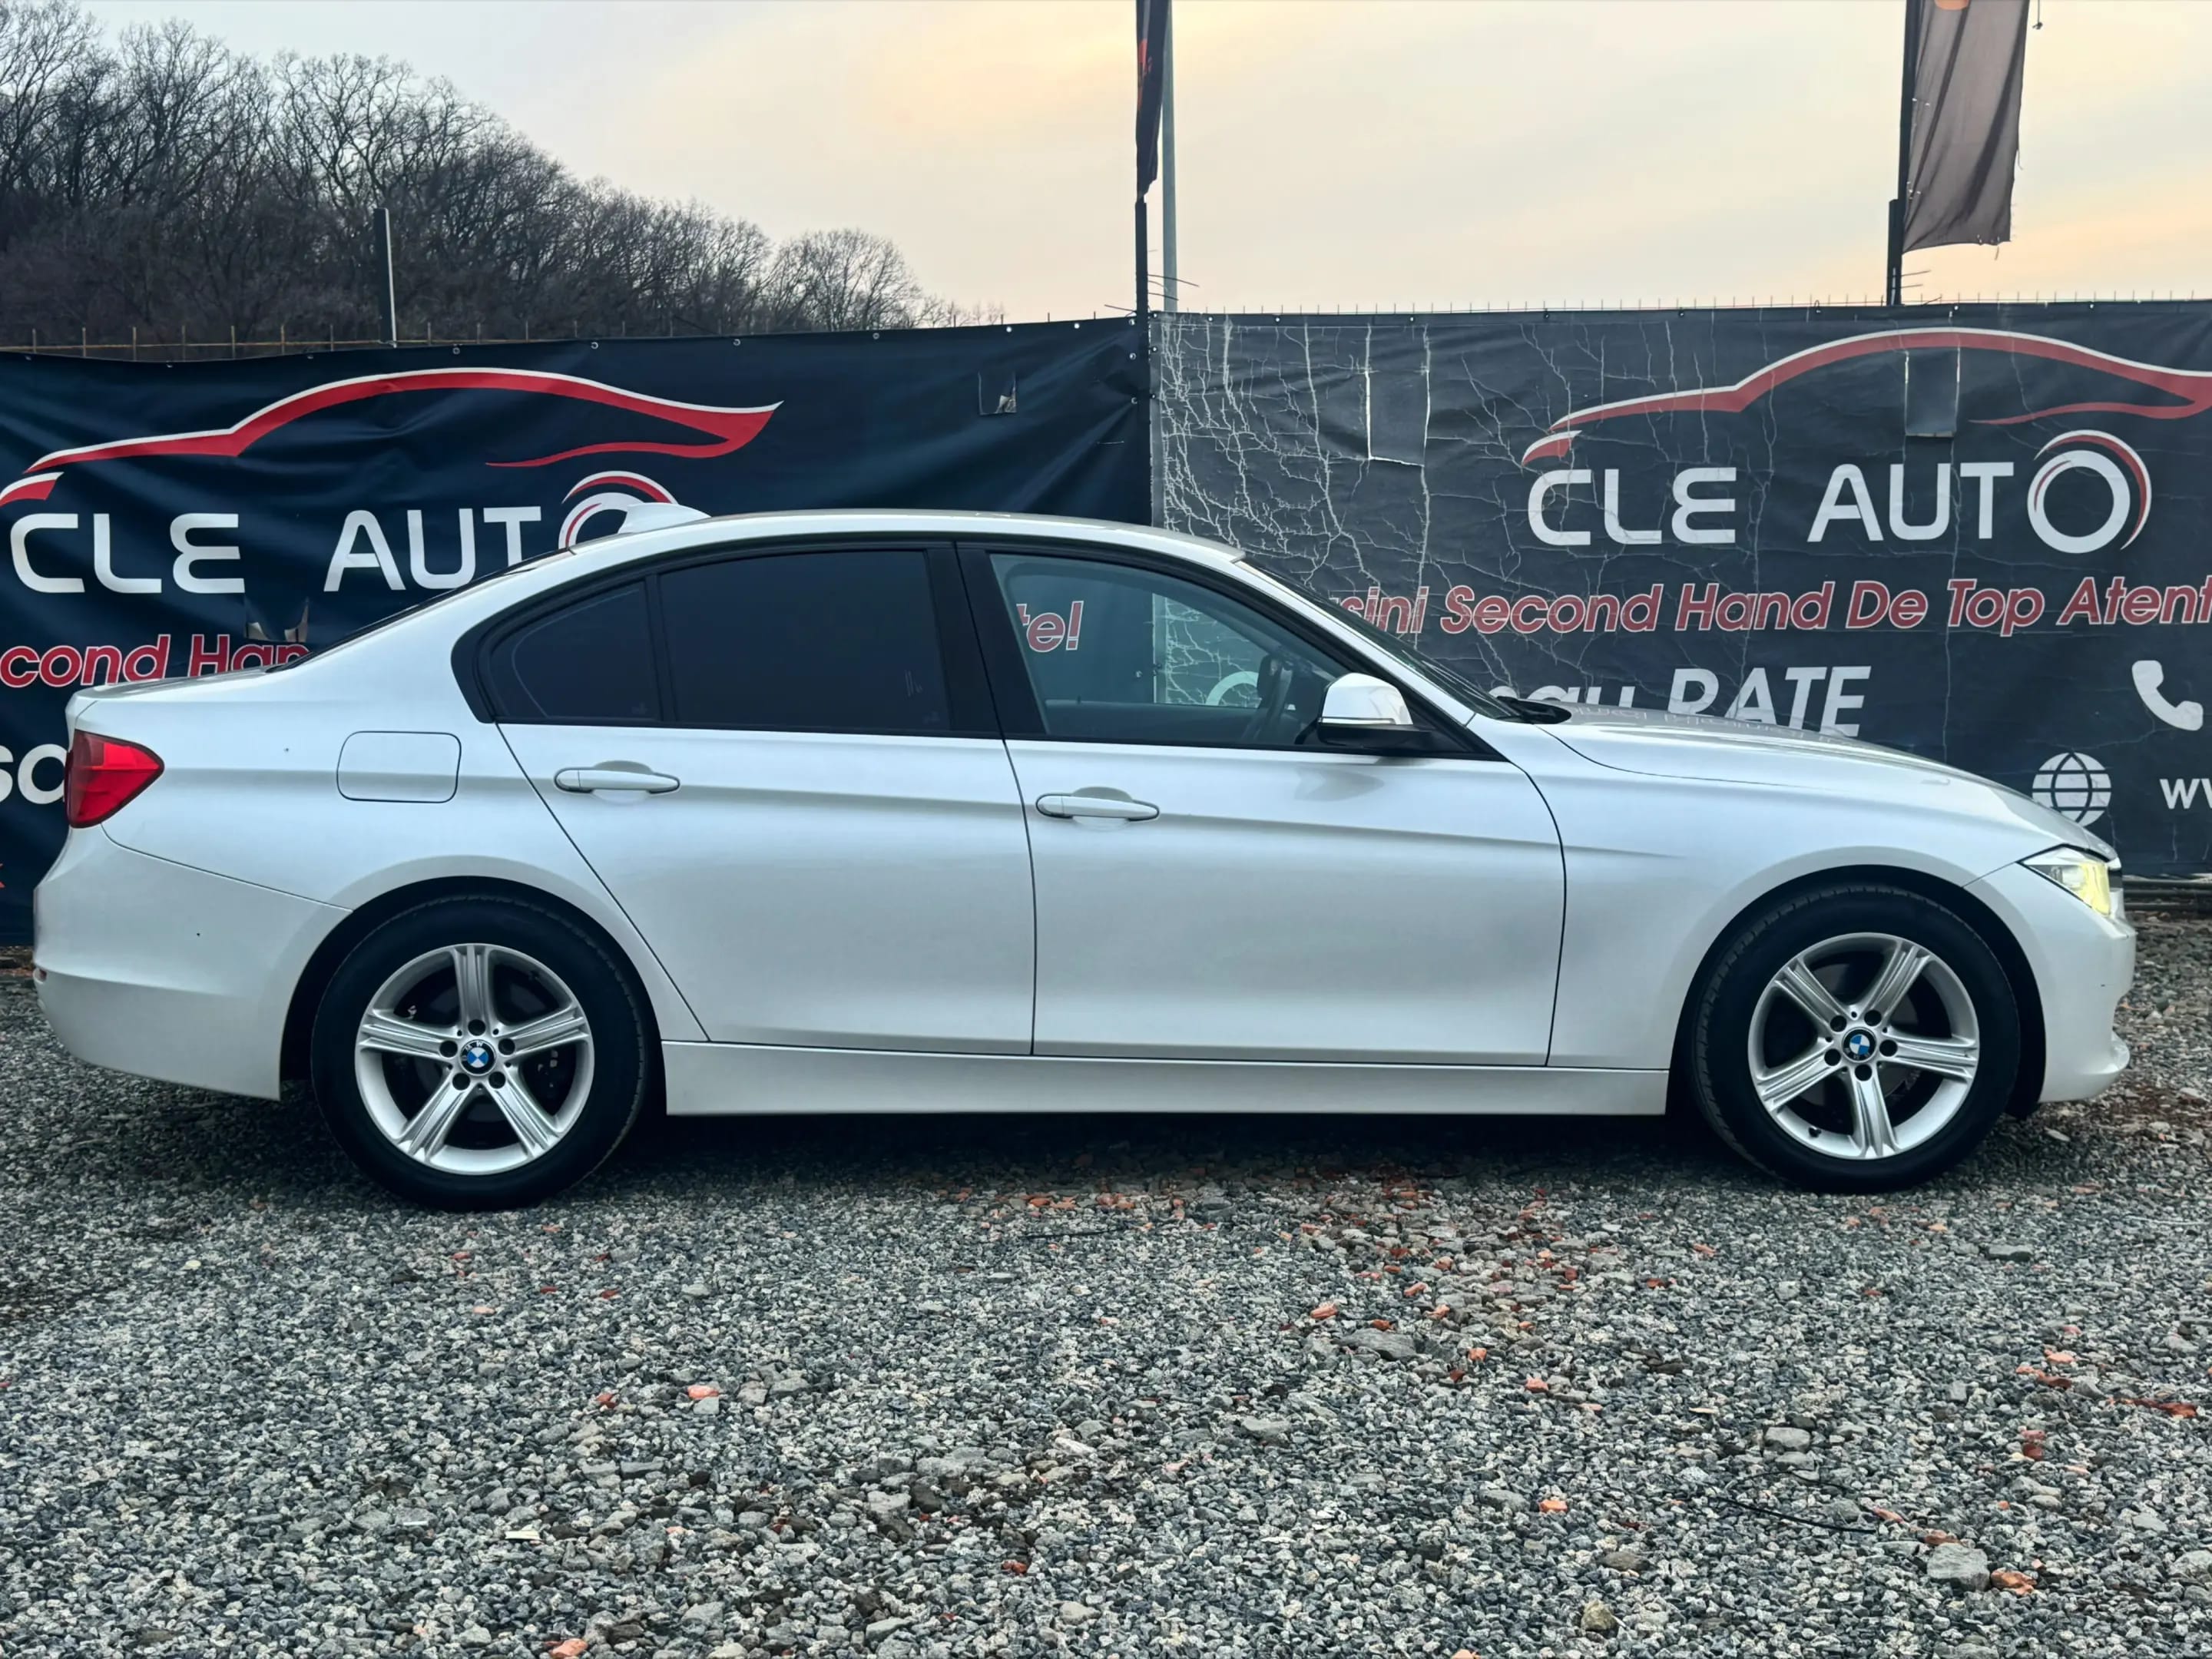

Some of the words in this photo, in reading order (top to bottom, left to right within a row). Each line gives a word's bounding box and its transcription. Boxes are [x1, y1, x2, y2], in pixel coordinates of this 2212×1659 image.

[1527, 466, 1737, 546] CLE
[1806, 449, 2131, 554] AUTO
[11, 512, 245, 594] CLE
[1439, 584, 1664, 635] Second
[1674, 581, 1836, 631] Hand
[1846, 581, 1929, 629] De
[1947, 578, 2045, 637] Top
[1667, 665, 1872, 738] RATE
